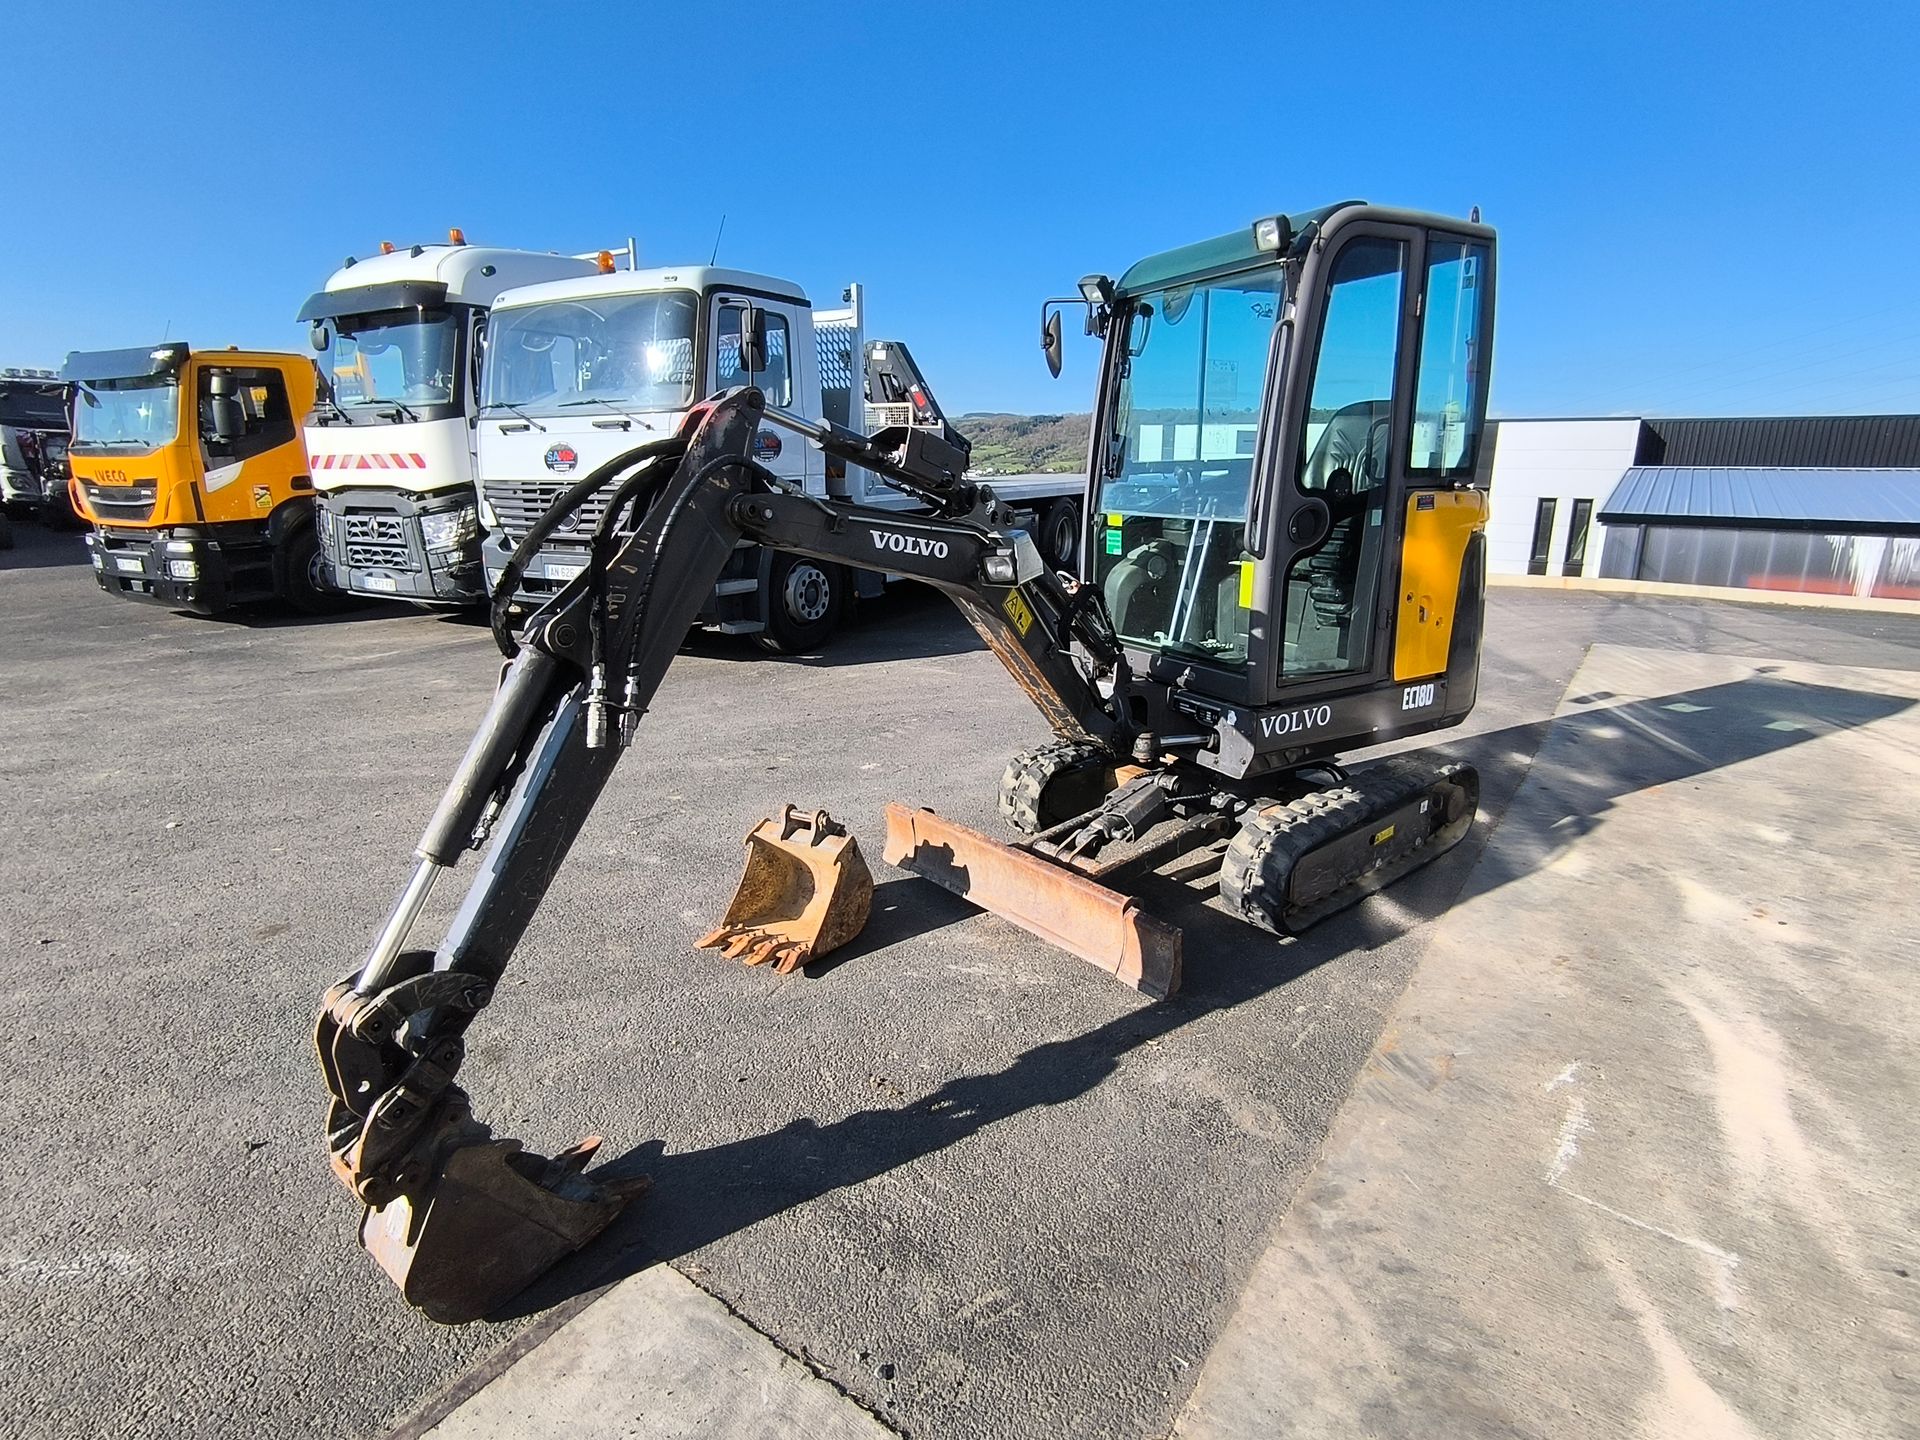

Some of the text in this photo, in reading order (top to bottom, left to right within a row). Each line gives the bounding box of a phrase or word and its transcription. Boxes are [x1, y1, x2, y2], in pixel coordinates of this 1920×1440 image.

[94, 469, 128, 482] IVECO
[869, 529, 949, 559] VOLVO
[1401, 683, 1435, 711] EC18D
[1259, 705, 1332, 739] VOLVO
